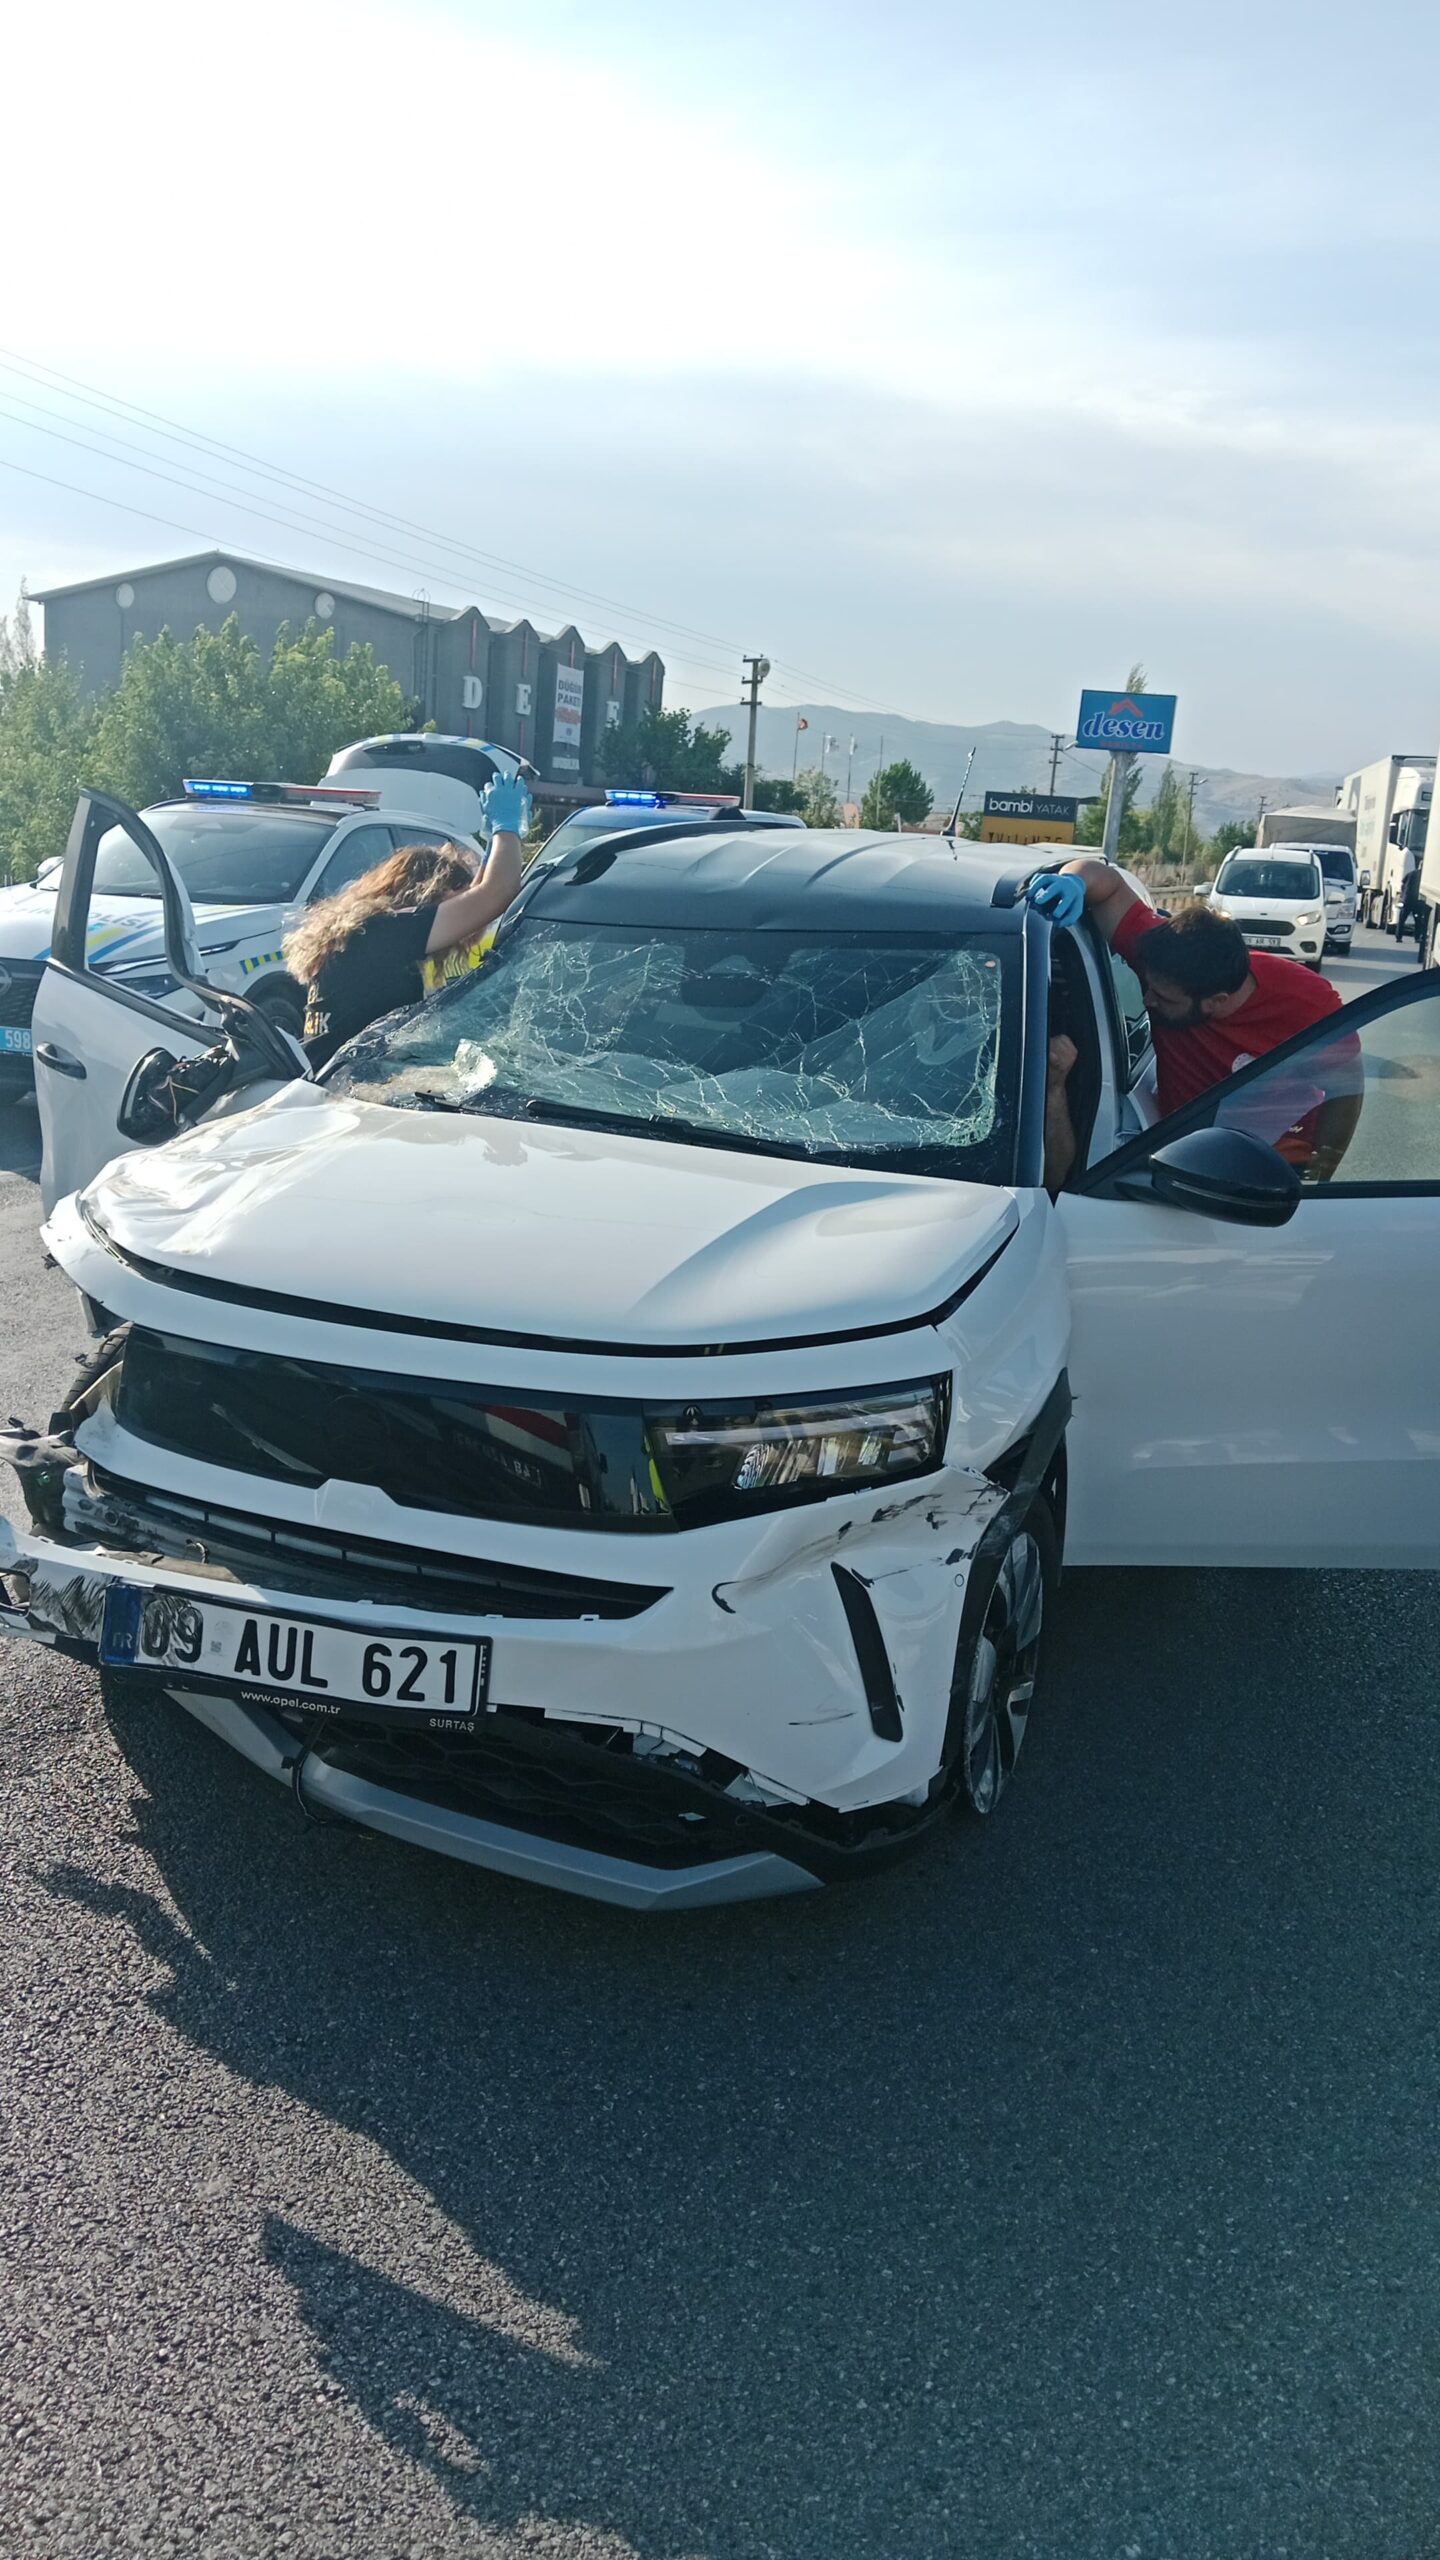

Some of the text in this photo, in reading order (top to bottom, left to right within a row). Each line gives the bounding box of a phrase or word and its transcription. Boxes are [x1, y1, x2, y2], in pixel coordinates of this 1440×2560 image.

[1082, 711, 1164, 741] desen
[989, 798, 1070, 817] bambi YATAK
[4, 1029, 31, 1050] 598
[141, 1598, 204, 1664] 09
[233, 1618, 329, 1690] AUL
[361, 1642, 459, 1704] 621
[240, 1690, 341, 1715] www.opel.com.tr
[428, 1717, 475, 1734] SURTAŞ
